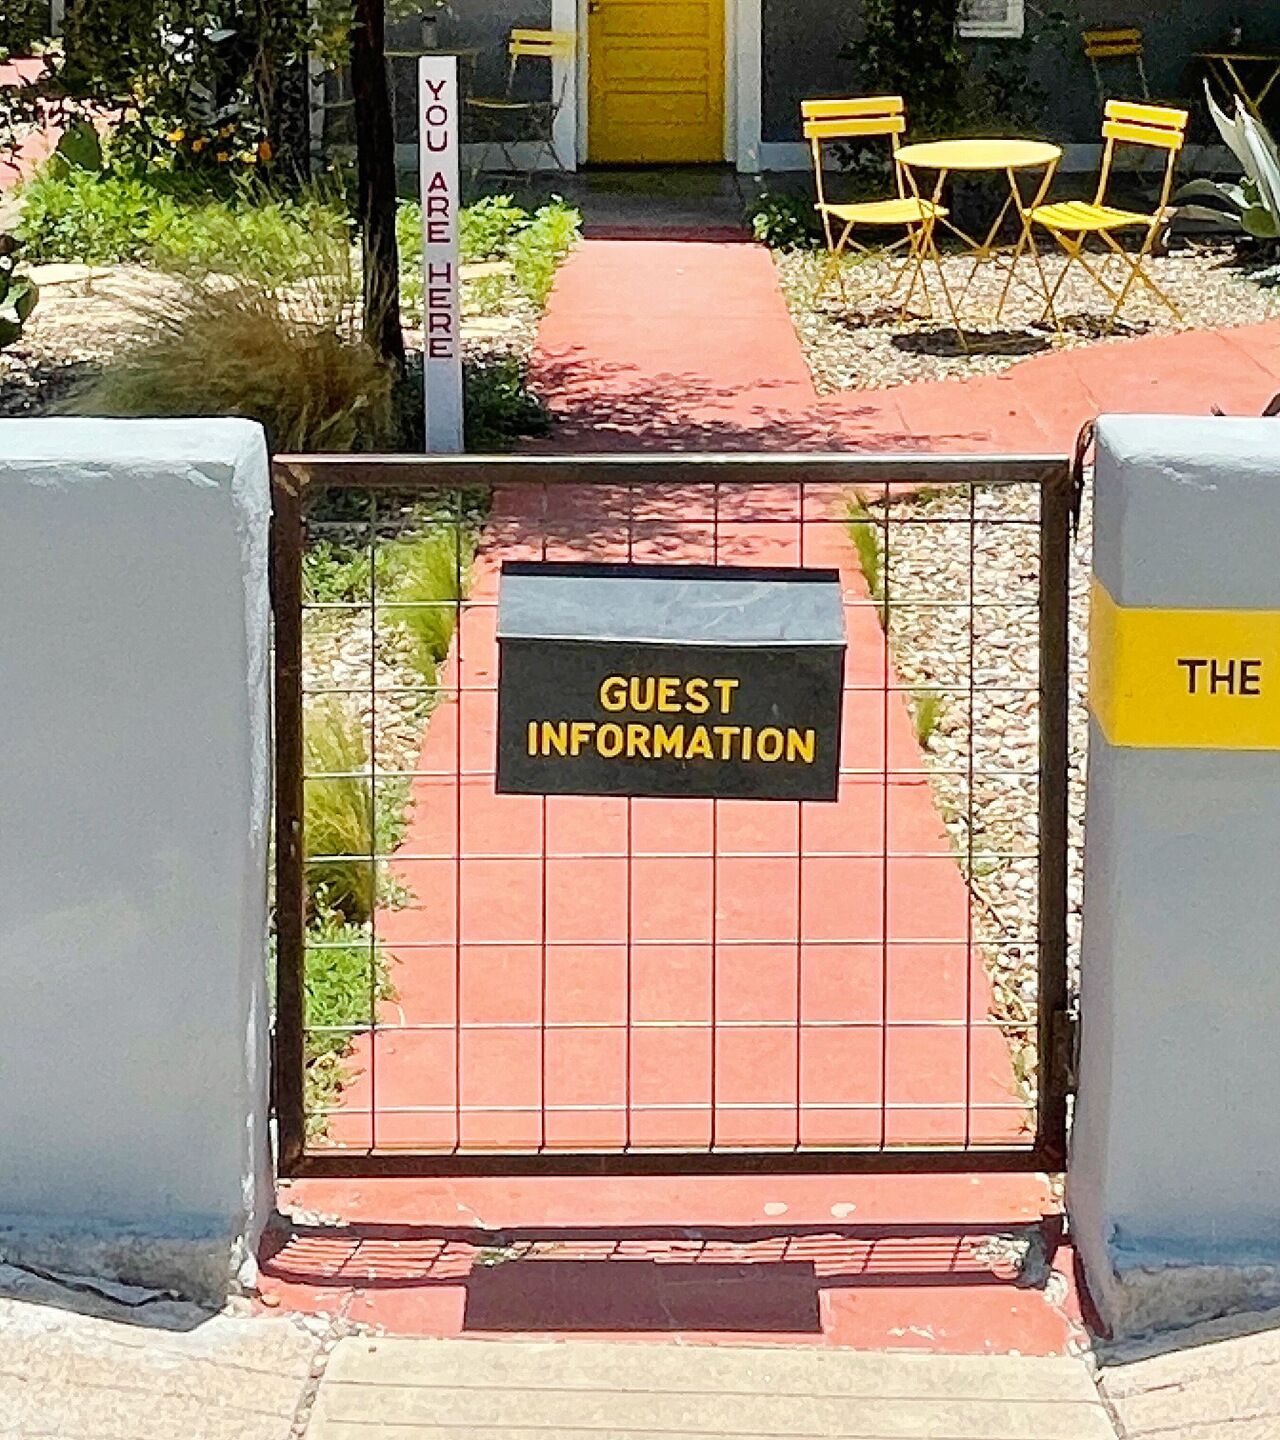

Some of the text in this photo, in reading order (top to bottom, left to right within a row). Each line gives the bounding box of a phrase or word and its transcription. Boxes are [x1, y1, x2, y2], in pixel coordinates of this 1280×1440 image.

[425, 79, 453, 359] YOU ARE HERE
[600, 676, 739, 714] GUEST
[1176, 657, 1262, 696] THE
[527, 721, 816, 763] INFORMATION
